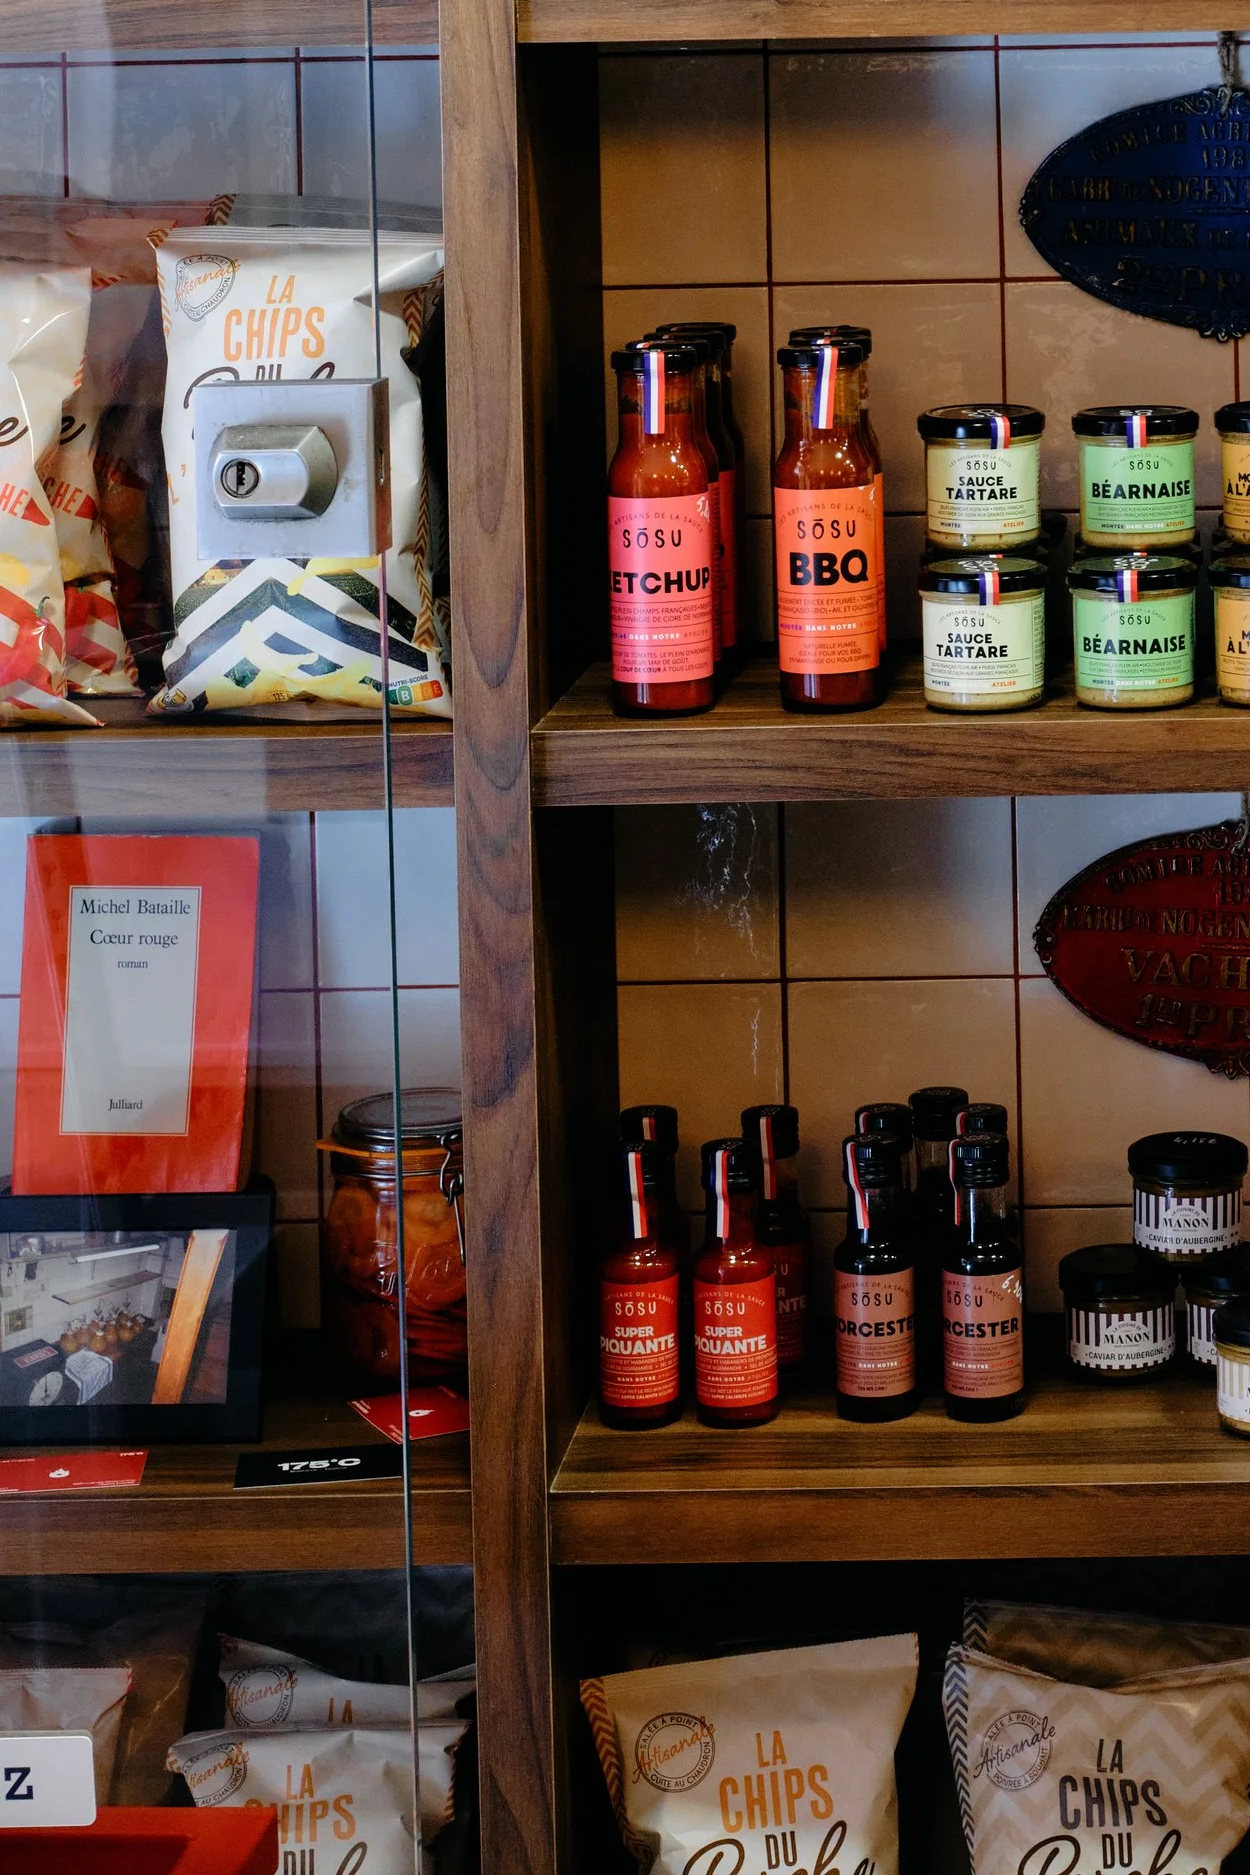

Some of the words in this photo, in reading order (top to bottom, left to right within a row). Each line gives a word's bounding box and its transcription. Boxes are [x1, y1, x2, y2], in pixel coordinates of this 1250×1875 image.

[266, 275, 295, 305] LA
[223, 306, 325, 361] CHIPS
[959, 476, 1003, 486] SAUCE
[1092, 479, 1190, 499] BÉARNAISE
[946, 487, 1018, 500] TARTARE
[790, 549, 869, 585] BBQ
[948, 633, 992, 644] SAUCE
[1083, 634, 1186, 655] BÉARNAISE
[937, 645, 1008, 657] TARTARE
[80, 898, 130, 915] Michel
[137, 899, 191, 915] Bataille
[90, 929, 132, 946] Cœur
[139, 932, 178, 947] rouge
[117, 959, 148, 969] roman
[108, 1098, 143, 1111] Julliard
[1163, 1217, 1209, 1229] MANON
[1149, 1235, 1173, 1244] CAVIAR
[1176, 1235, 1224, 1245] D'AUBERGINE
[615, 1326, 654, 1337] SUPER
[705, 1326, 743, 1337] SUPER
[600, 1333, 674, 1354] PIQUANTE
[1089, 1352, 1115, 1360] CAVIAR
[632, 1715, 716, 1784] Artisanale
[755, 1730, 787, 1767] LA
[973, 1715, 1056, 1778] Artisanale
[1096, 1738, 1123, 1774] LA
[286, 1763, 314, 1799] LA
[719, 1765, 834, 1833] CHIPS
[1059, 1775, 1168, 1830] CHIPS
[765, 1831, 798, 1869] DU
[1102, 1833, 1132, 1869] DU
